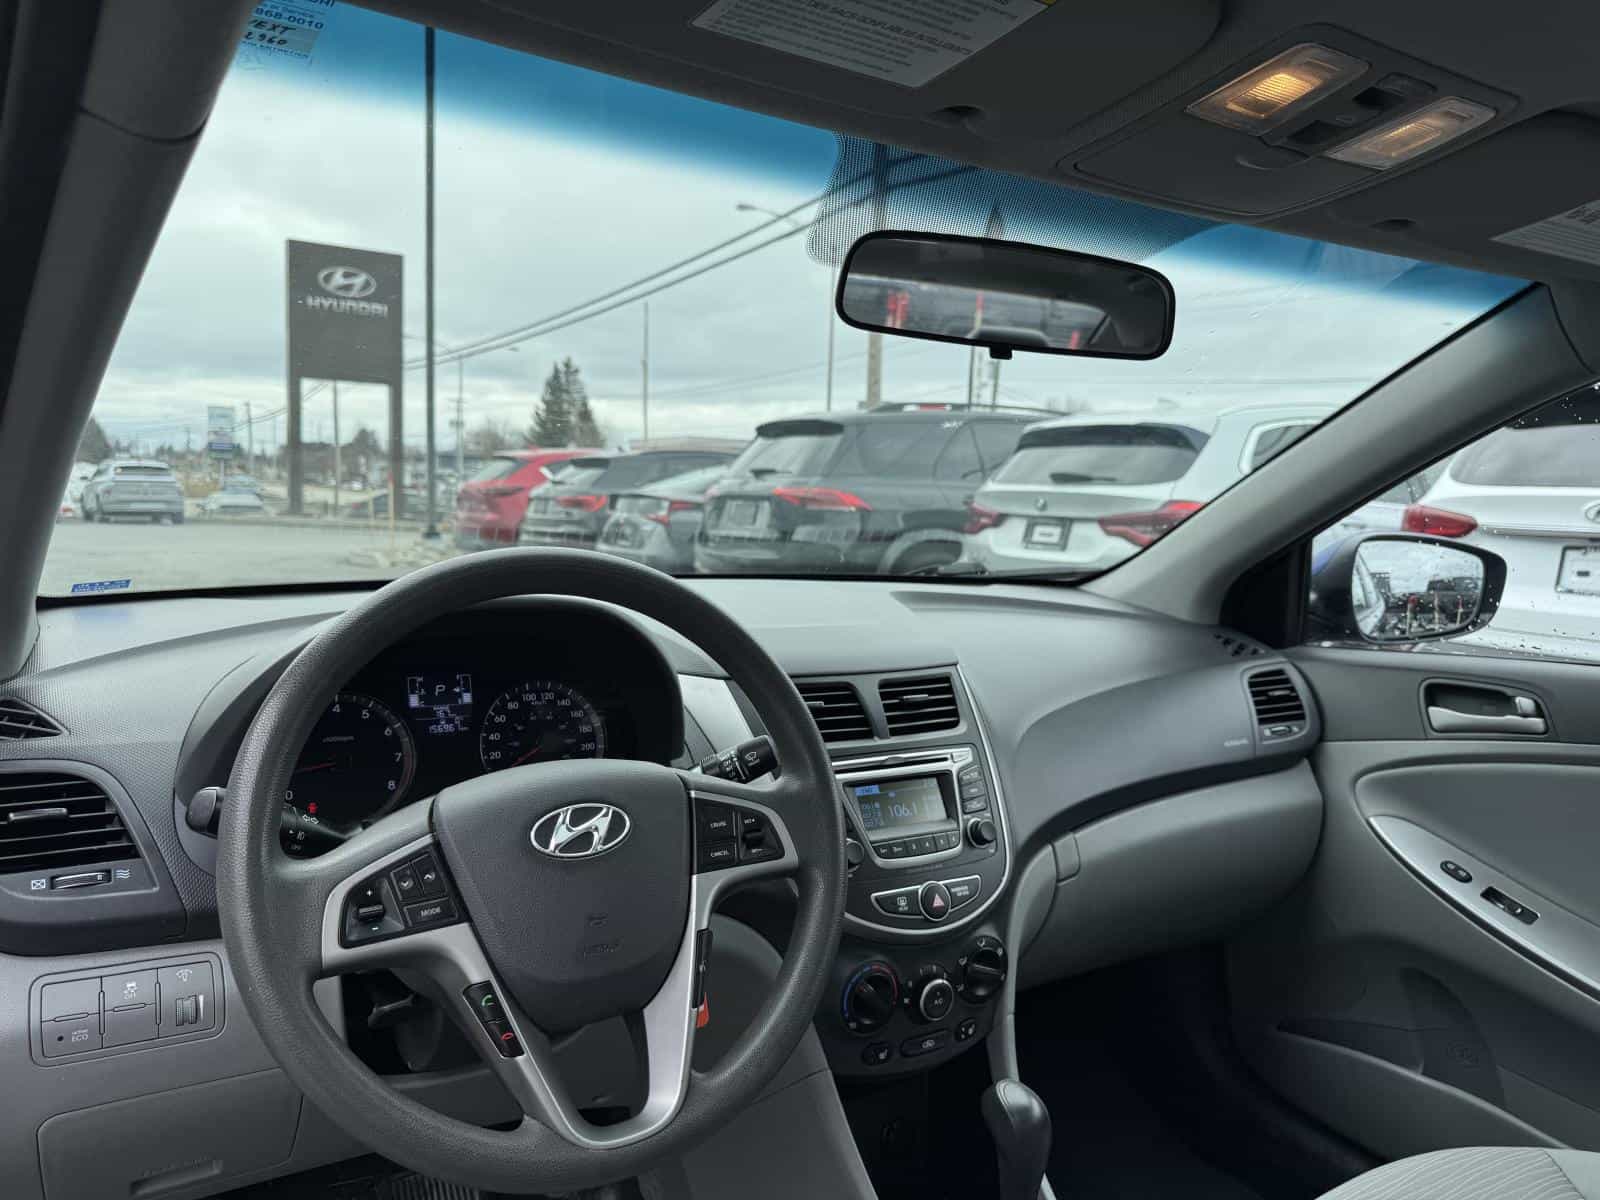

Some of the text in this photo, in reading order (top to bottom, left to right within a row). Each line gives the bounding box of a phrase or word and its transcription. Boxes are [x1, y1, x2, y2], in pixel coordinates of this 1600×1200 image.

[306, 296, 388, 319] HYUNDAI
[435, 684, 446, 697] P
[522, 693, 536, 702] 100
[542, 692, 555, 701] 120
[332, 704, 341, 713] 4
[507, 701, 519, 710] 80
[361, 710, 370, 719] 5
[493, 714, 506, 723] 60
[384, 727, 393, 736] 6
[488, 732, 501, 741] 40
[394, 752, 402, 762] 7
[488, 752, 502, 760] 20
[387, 779, 397, 790] 8
[285, 790, 294, 801] 0
[888, 801, 918, 818] 106.1
[420, 906, 441, 917] MODE
[71, 1034, 89, 1043] ECO
